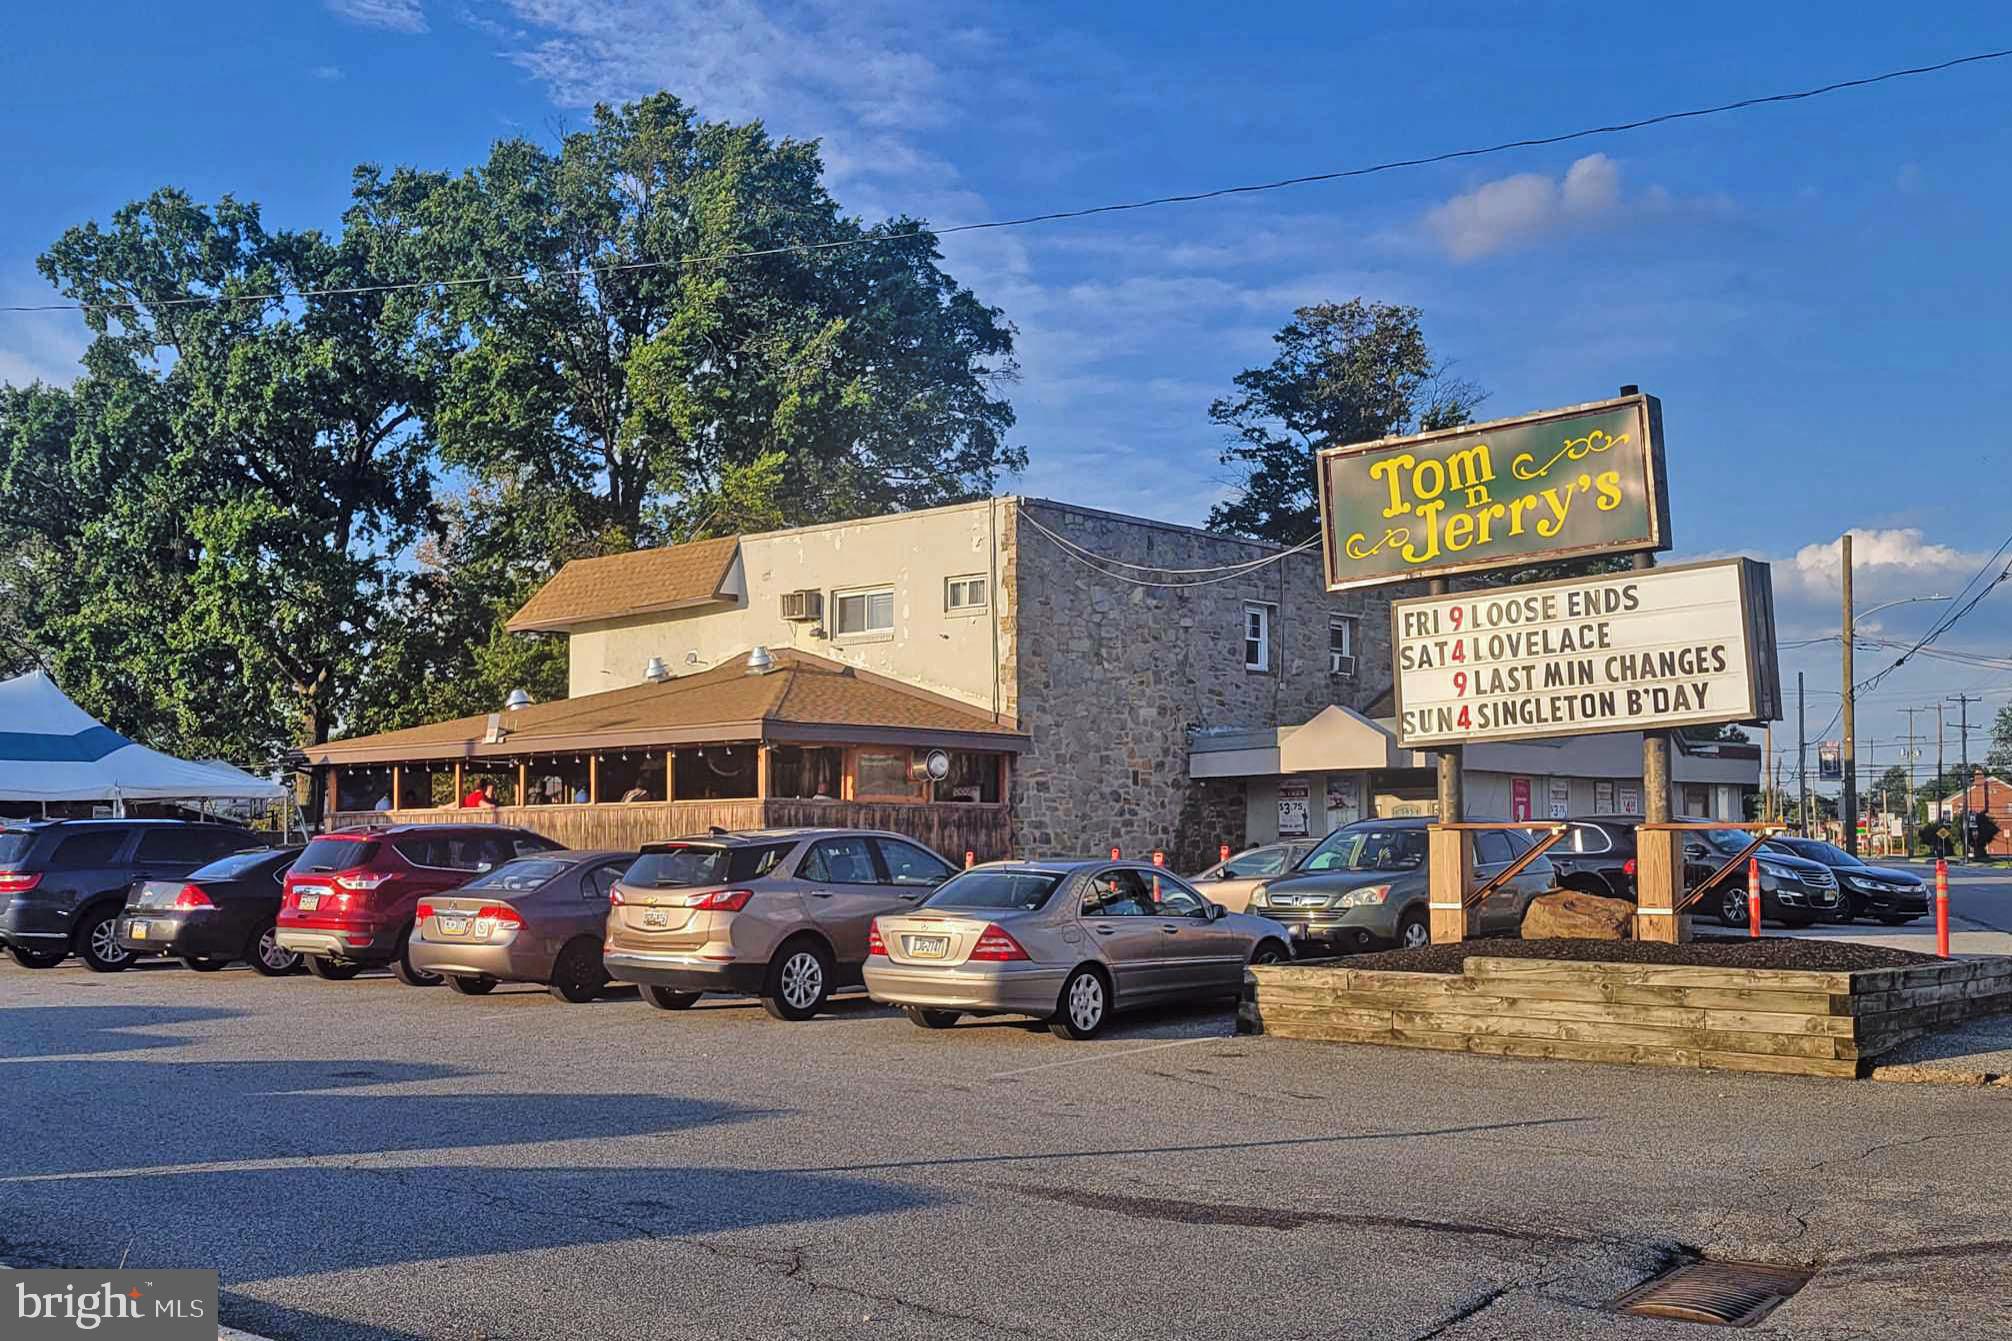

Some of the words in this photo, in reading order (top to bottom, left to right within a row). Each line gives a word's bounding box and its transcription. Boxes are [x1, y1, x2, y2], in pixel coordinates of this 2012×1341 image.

[1370, 444, 1496, 518] Tom
[1465, 482, 1492, 508] n
[1402, 471, 1622, 563] Jerry's
[1404, 609, 1440, 637] FRI
[1449, 606, 1463, 632] 9
[1472, 595, 1557, 629] LOOSE
[1567, 584, 1639, 617] ENDS
[1400, 641, 1448, 670] SAT
[1452, 639, 1466, 664] 4
[1473, 622, 1611, 661] LOVELACE
[1453, 671, 1467, 697] 9
[1474, 665, 1535, 695] LAST
[1544, 659, 1594, 688] MIN
[1604, 645, 1726, 683] CHANGES
[1403, 707, 1453, 735] SUN
[1457, 704, 1472, 730] 4
[1477, 690, 1616, 729] SINGLETON
[1626, 682, 1709, 716] B'DAY
